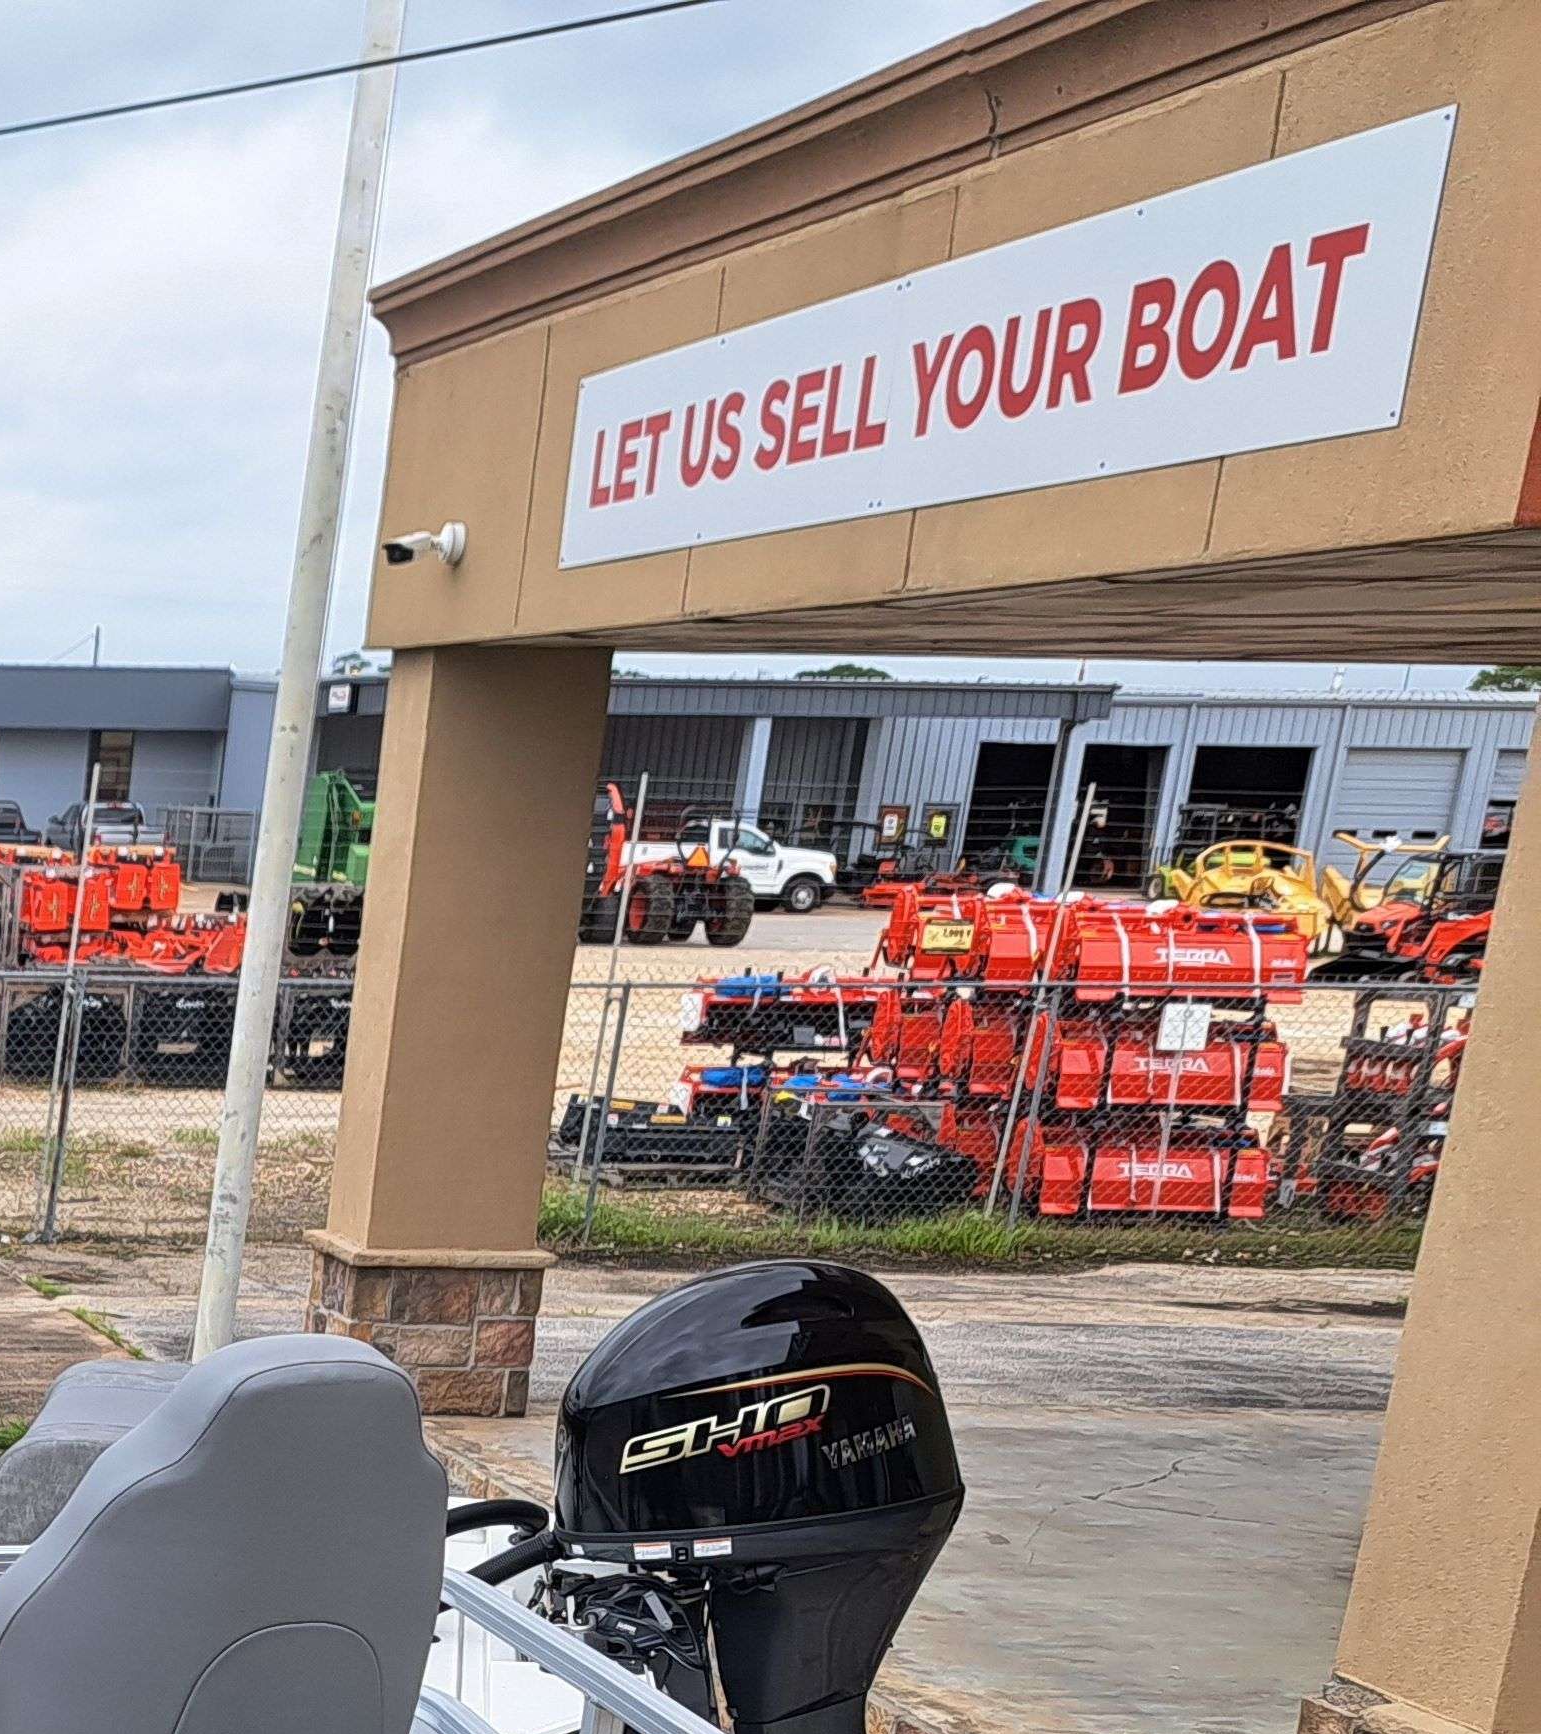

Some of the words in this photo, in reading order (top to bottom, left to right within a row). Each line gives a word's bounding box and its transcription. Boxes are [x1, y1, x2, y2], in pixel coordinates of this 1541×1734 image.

[588, 410, 670, 509] LET
[679, 391, 742, 488] US
[754, 355, 887, 471] SELL
[912, 296, 1103, 438] YOUR
[1117, 222, 1370, 396] BOAT
[619, 1384, 830, 1474] SHO
[821, 1415, 917, 1468] YAMAHA
